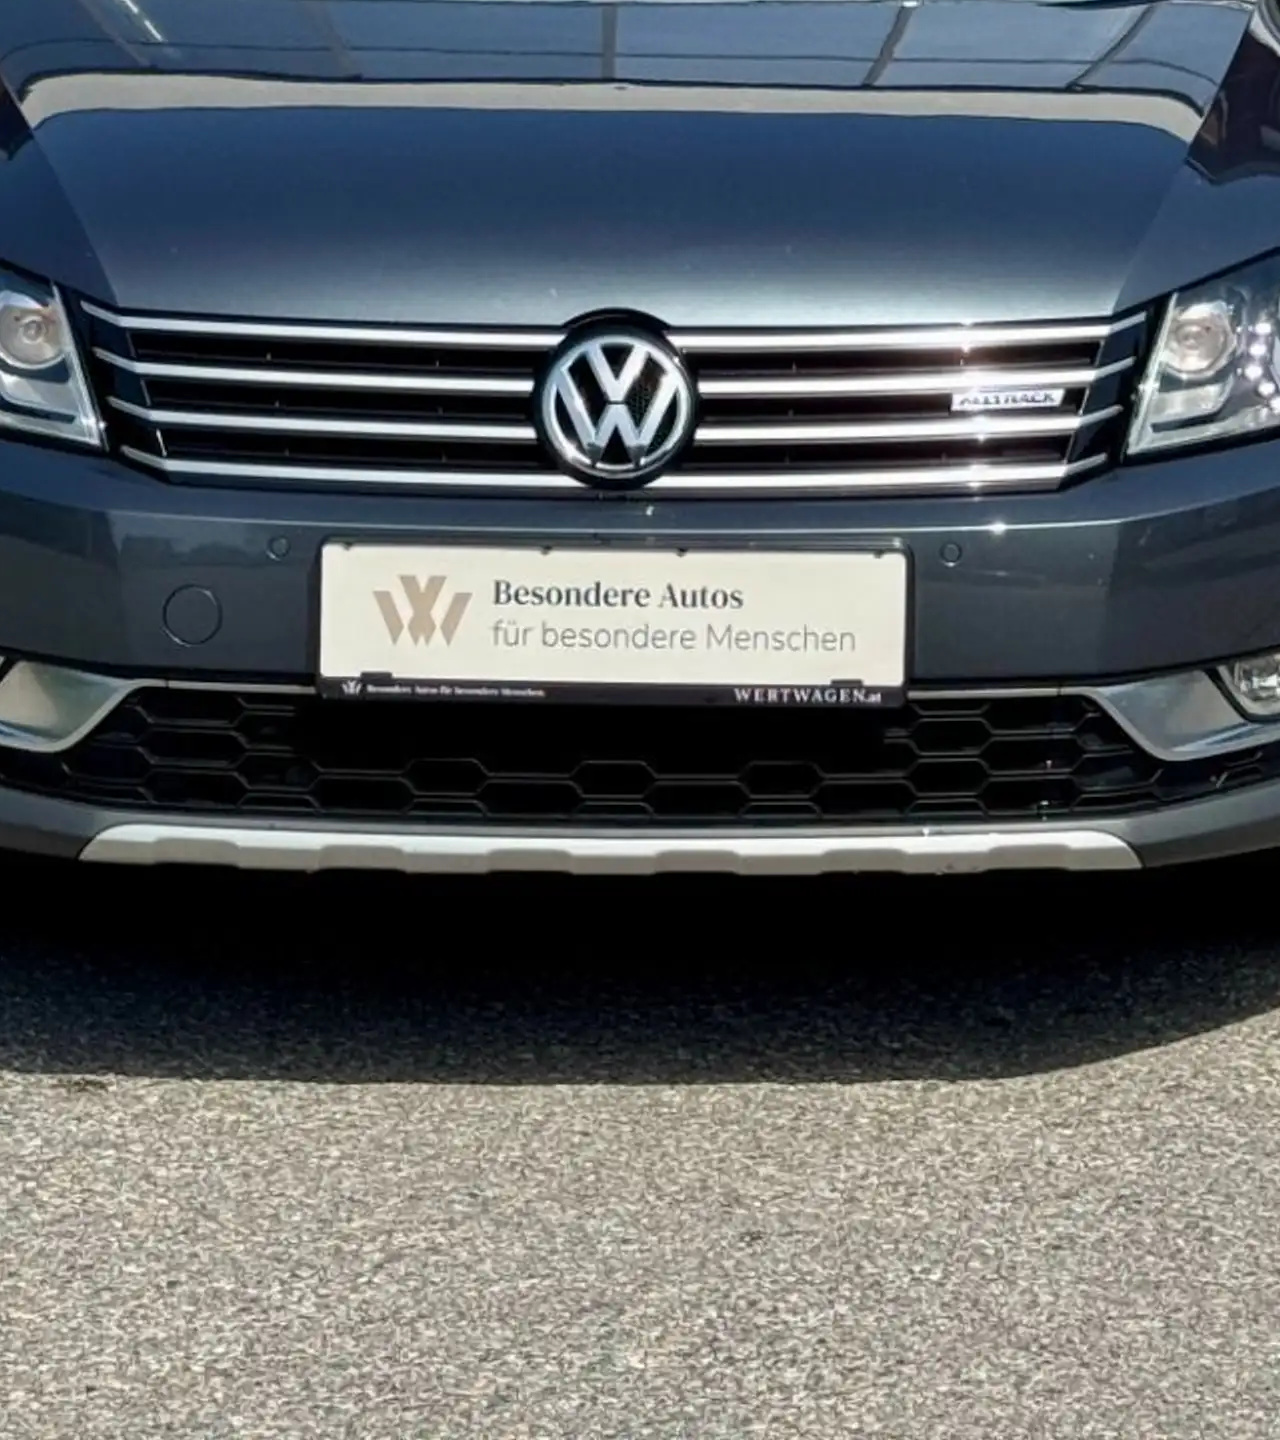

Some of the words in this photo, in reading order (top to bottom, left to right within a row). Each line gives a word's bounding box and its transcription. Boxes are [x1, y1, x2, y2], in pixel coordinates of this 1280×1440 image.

[492, 579, 651, 608] Besondere
[657, 582, 744, 610] Autos
[491, 618, 535, 647] für
[541, 621, 697, 650] besondere
[705, 623, 857, 653] Menschen
